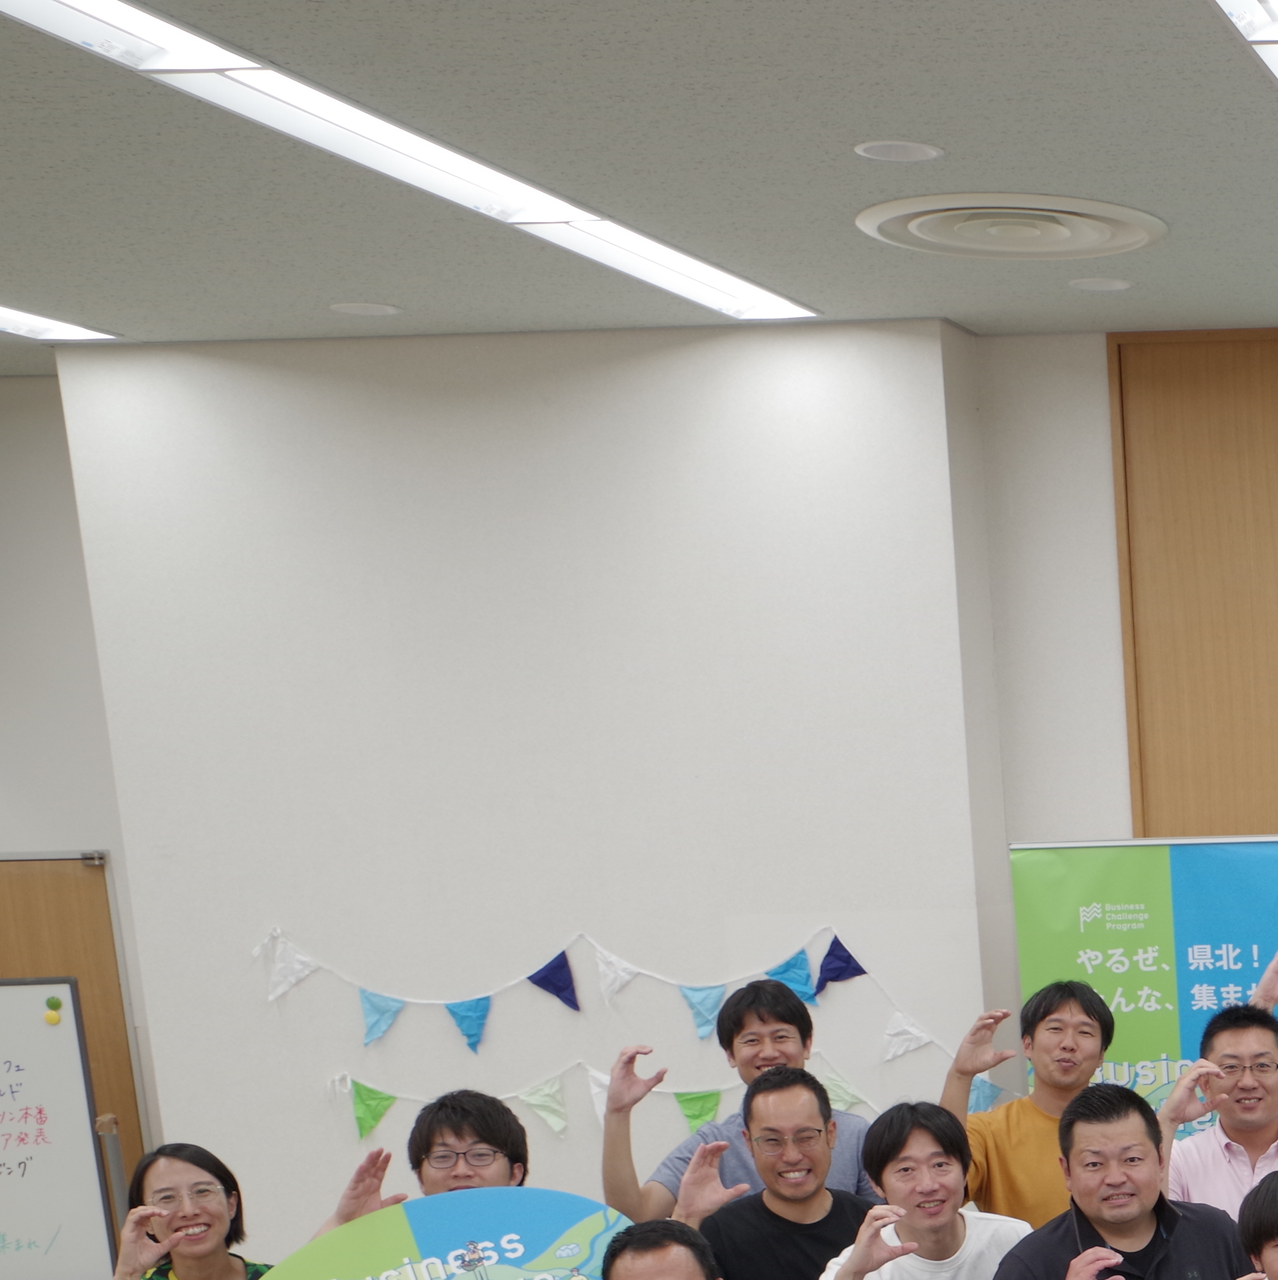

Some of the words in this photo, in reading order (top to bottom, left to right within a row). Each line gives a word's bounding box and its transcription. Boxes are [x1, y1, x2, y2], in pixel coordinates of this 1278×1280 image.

[1105, 902, 1145, 911] Business
[1105, 912, 1149, 921] Challenge
[1106, 922, 1145, 932] Program
